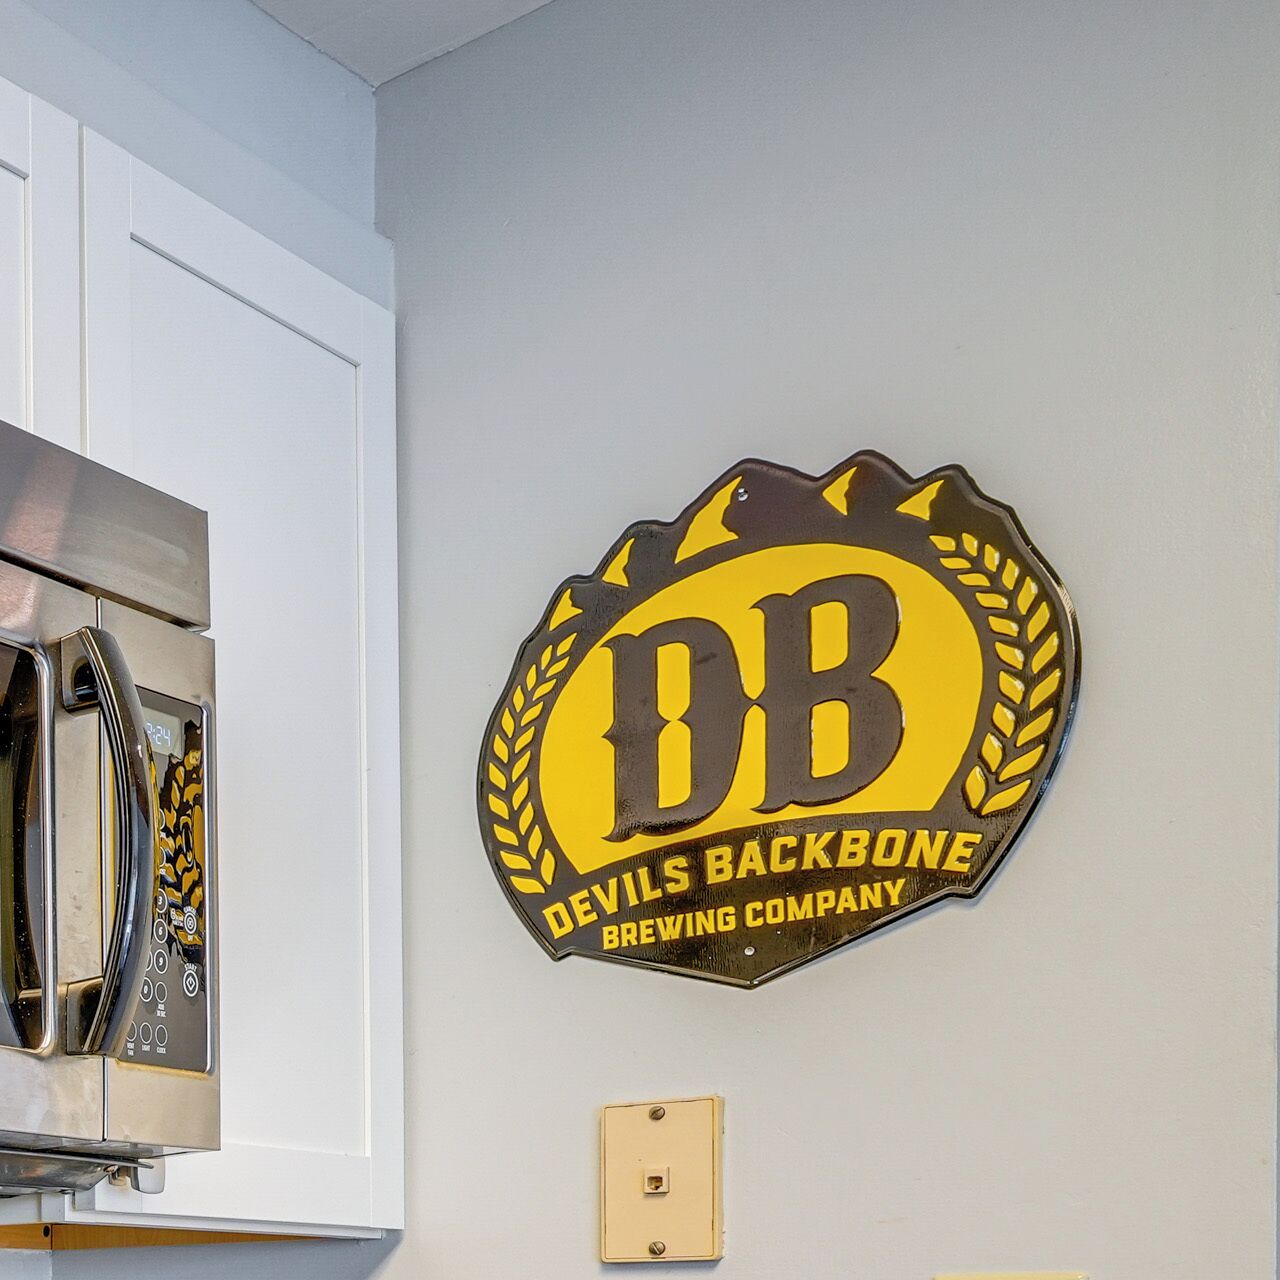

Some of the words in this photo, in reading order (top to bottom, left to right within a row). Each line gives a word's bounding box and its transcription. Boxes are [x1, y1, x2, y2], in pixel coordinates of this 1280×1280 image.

[602, 574, 906, 842] DB
[542, 856, 691, 940] DEVILS
[705, 829, 983, 888] BACKBONE
[602, 904, 737, 950] BREWING
[744, 878, 908, 929] COMPANY
[184, 962, 198, 971] START
